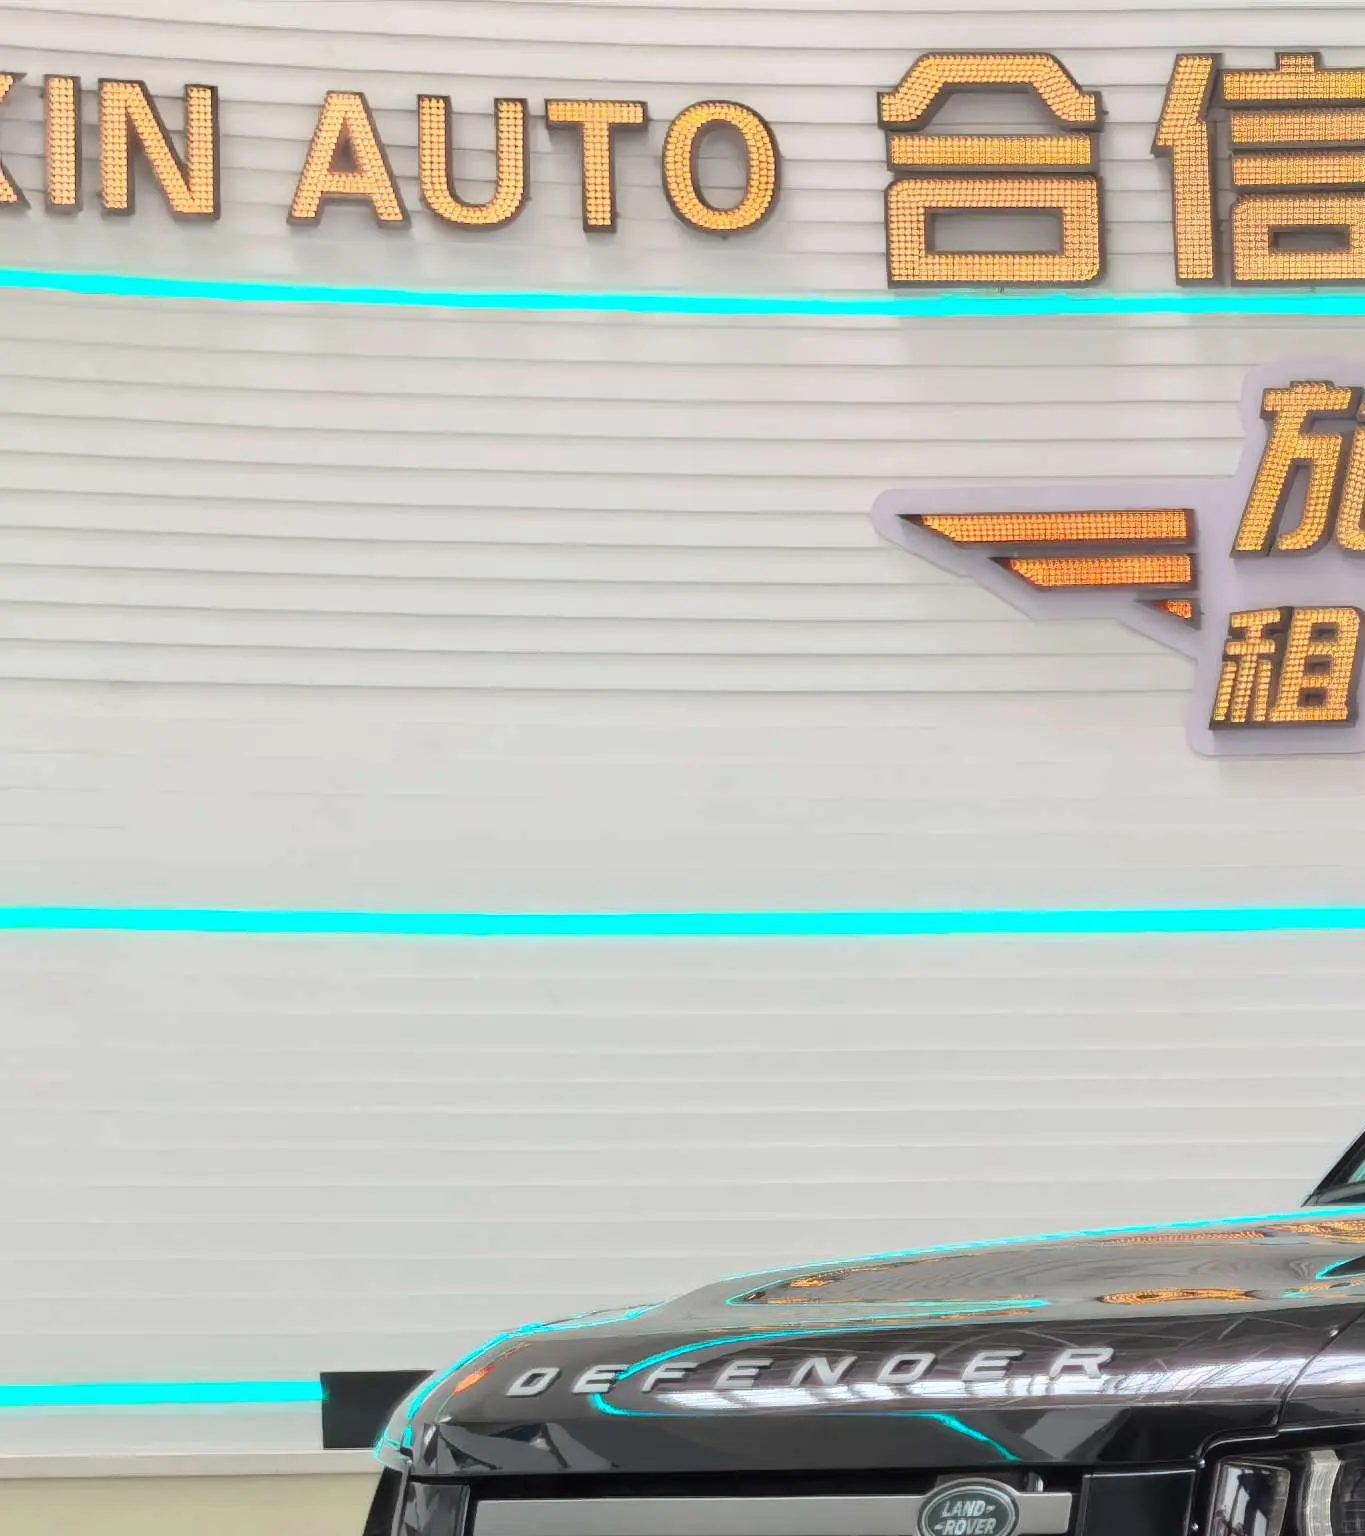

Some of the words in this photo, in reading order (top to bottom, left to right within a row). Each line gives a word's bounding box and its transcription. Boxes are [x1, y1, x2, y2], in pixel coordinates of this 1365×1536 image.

[286, 89, 783, 237] AUTO
[505, 1347, 1115, 1397] DEFENDER
[941, 1499, 987, 1518] LAND
[941, 1517, 998, 1536] ROVER
